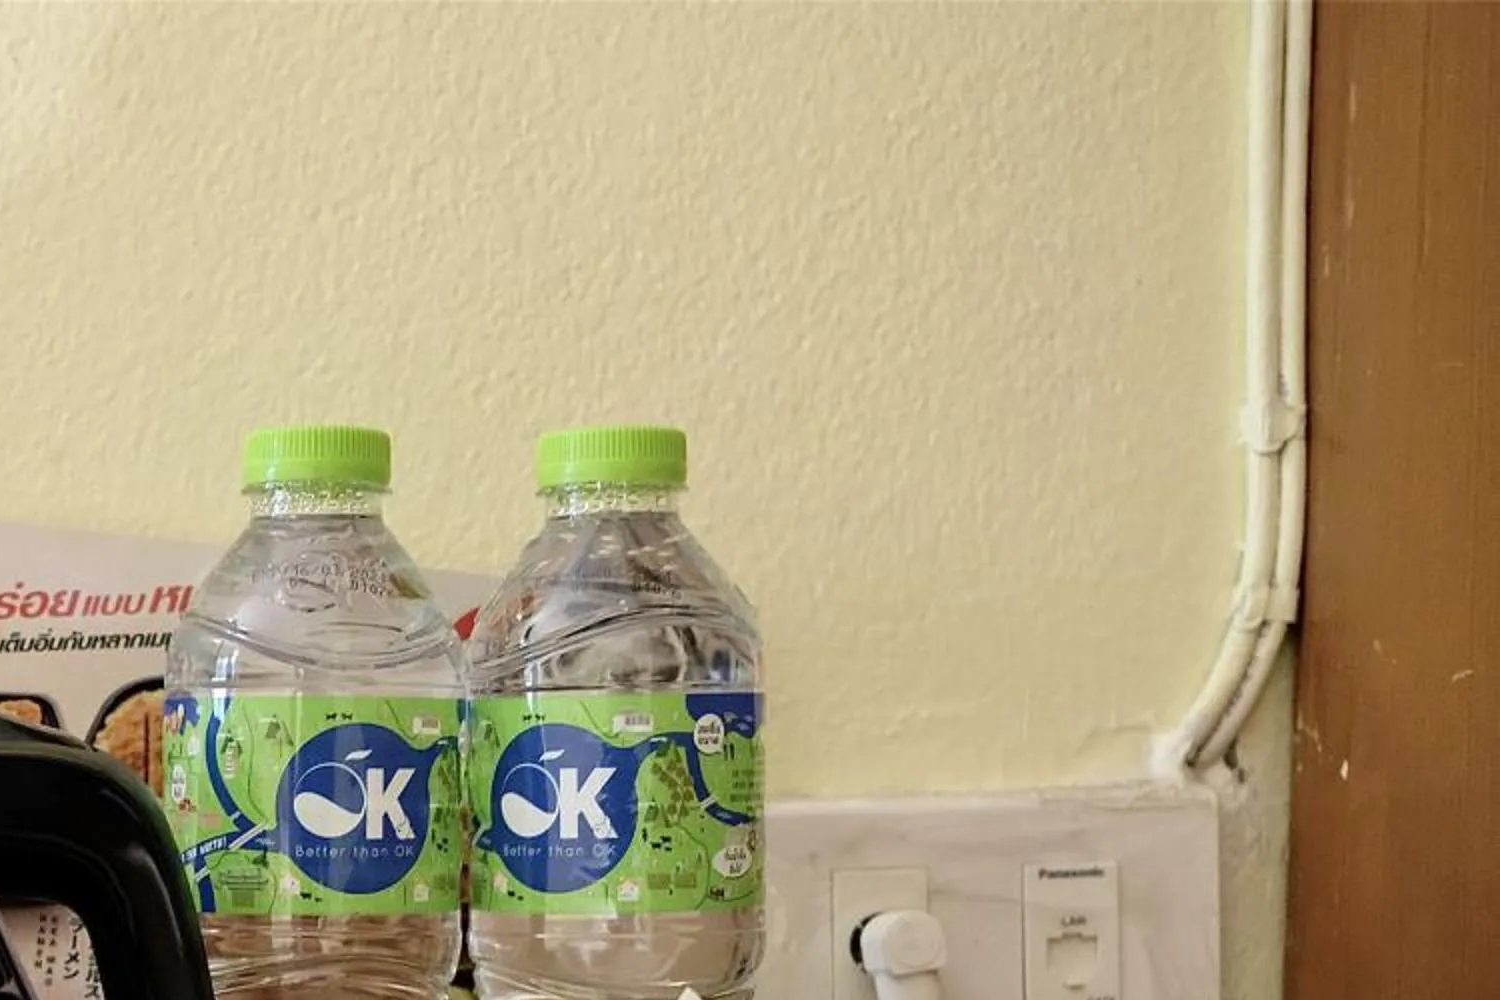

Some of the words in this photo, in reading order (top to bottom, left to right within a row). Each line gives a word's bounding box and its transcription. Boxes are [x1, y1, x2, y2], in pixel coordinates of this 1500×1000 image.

[293, 749, 416, 840] OK
[501, 749, 618, 839] OK
[295, 844, 346, 858] Better
[353, 845, 388, 858] than
[395, 844, 414, 858] OK
[548, 845, 585, 857] than
